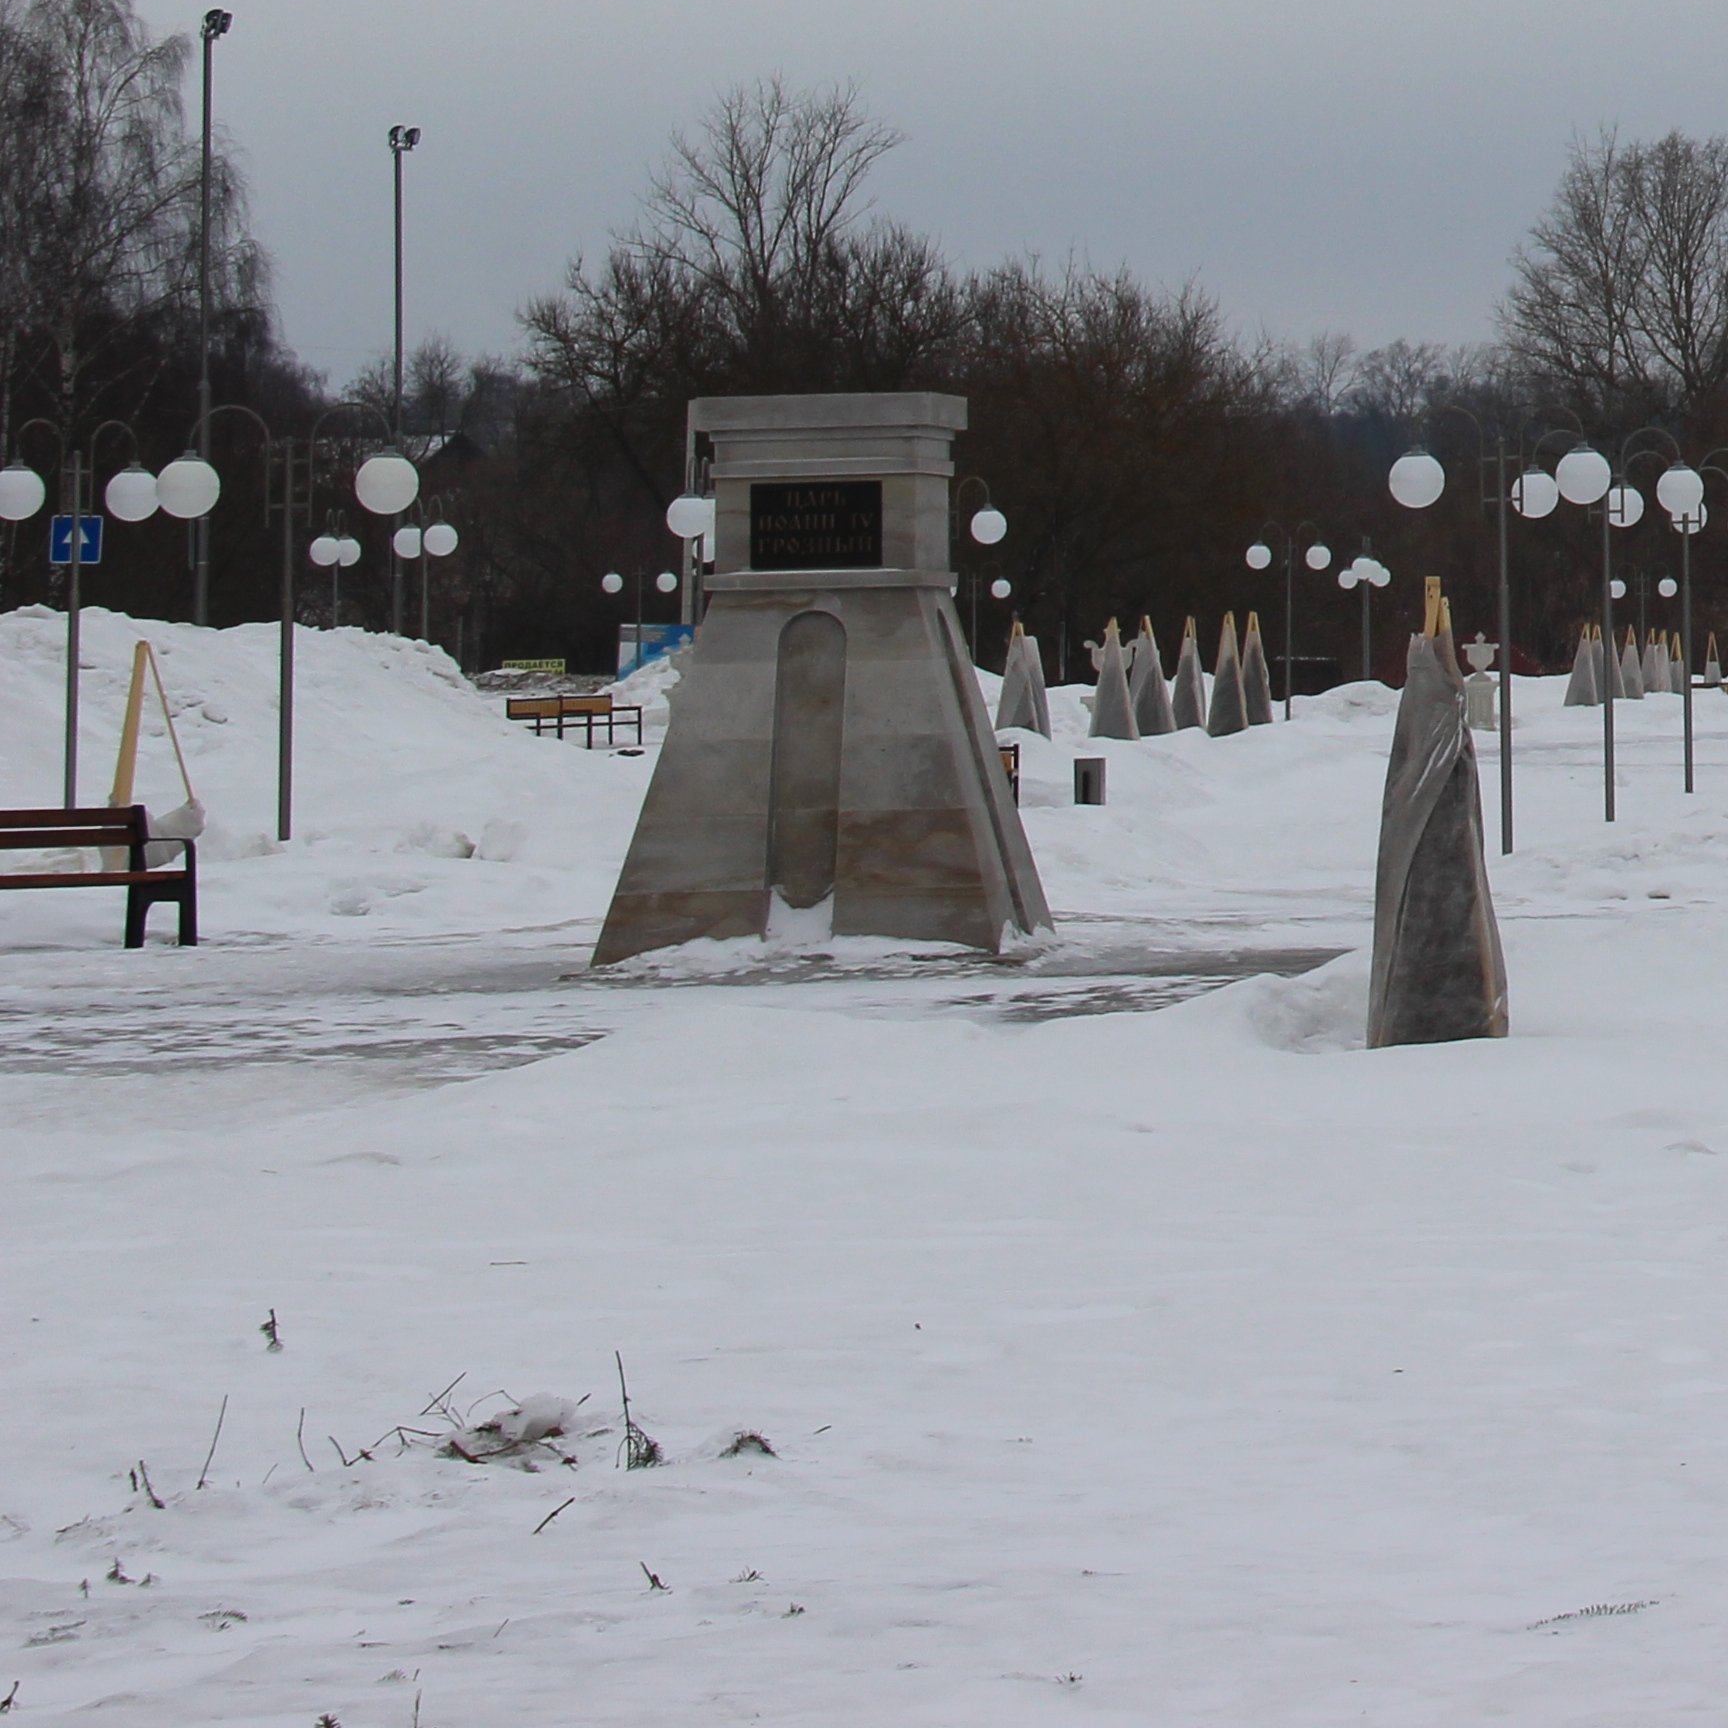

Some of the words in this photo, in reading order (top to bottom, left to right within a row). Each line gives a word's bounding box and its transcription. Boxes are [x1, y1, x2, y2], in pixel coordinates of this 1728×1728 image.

[787, 490, 847, 511] ЦАРЬ
[759, 514, 836, 531] ИОАНН
[851, 512, 875, 529] IV
[759, 533, 873, 555] ГРОЗНЫЙ
